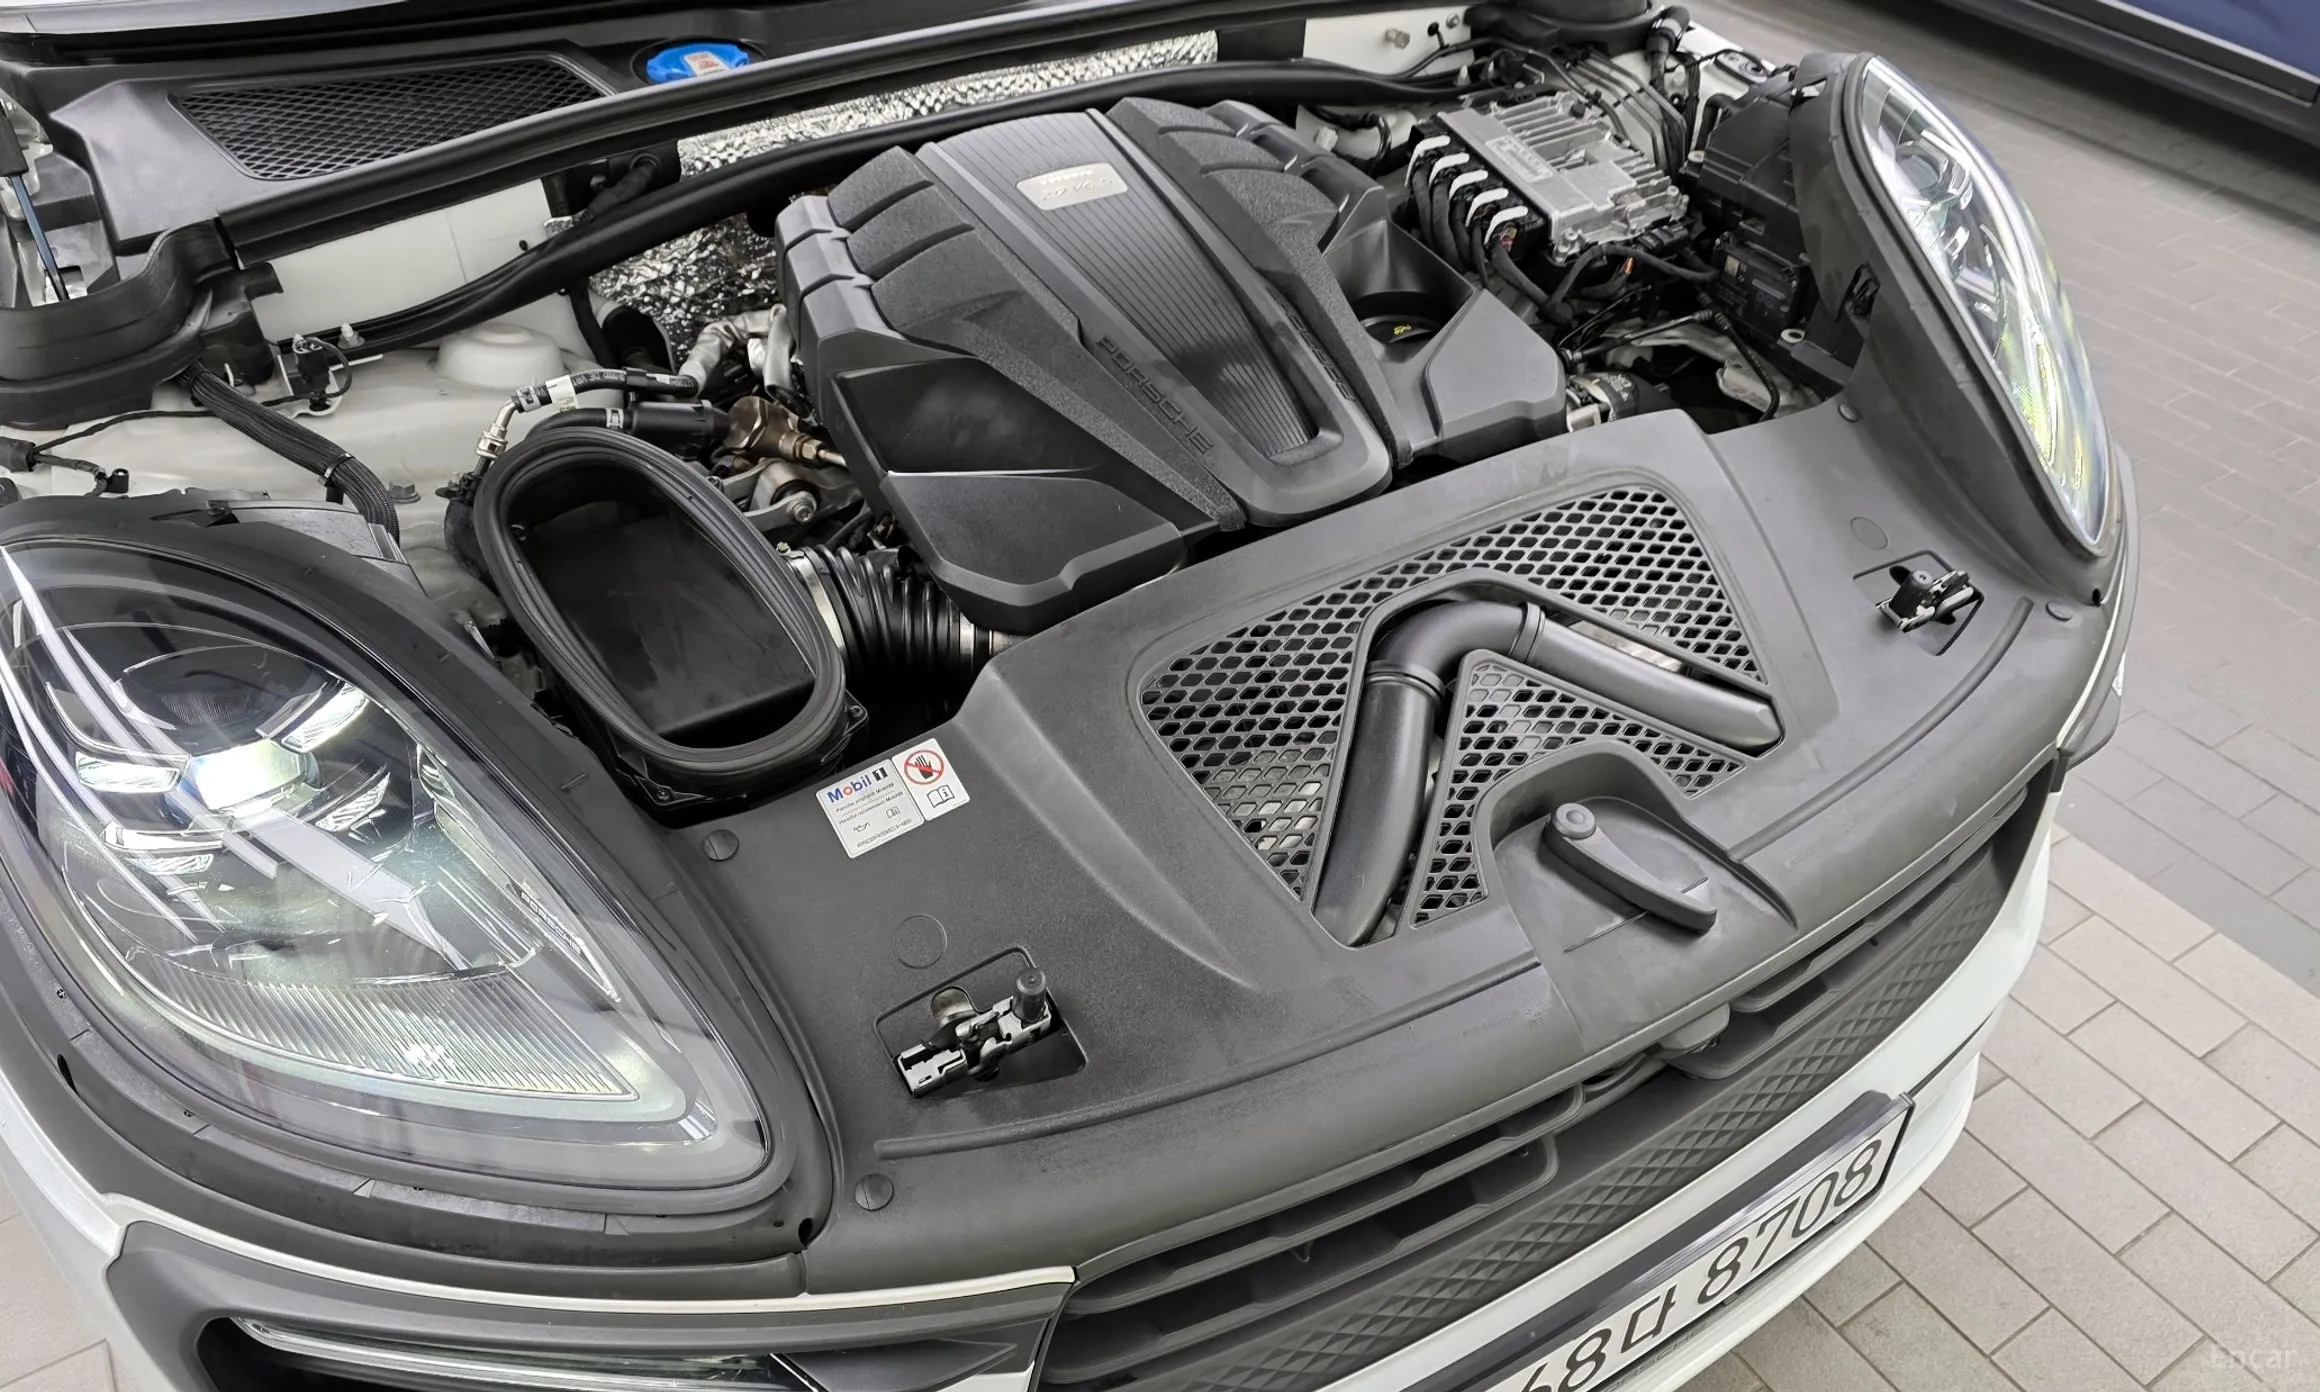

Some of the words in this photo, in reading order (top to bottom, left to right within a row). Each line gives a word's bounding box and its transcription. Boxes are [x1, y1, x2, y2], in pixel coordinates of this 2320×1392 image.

[1096, 336, 1215, 455] PORSCHE
[826, 775, 872, 803] Mobil
[872, 766, 889, 782] 1
[1697, 1138, 1883, 1305] 8708
